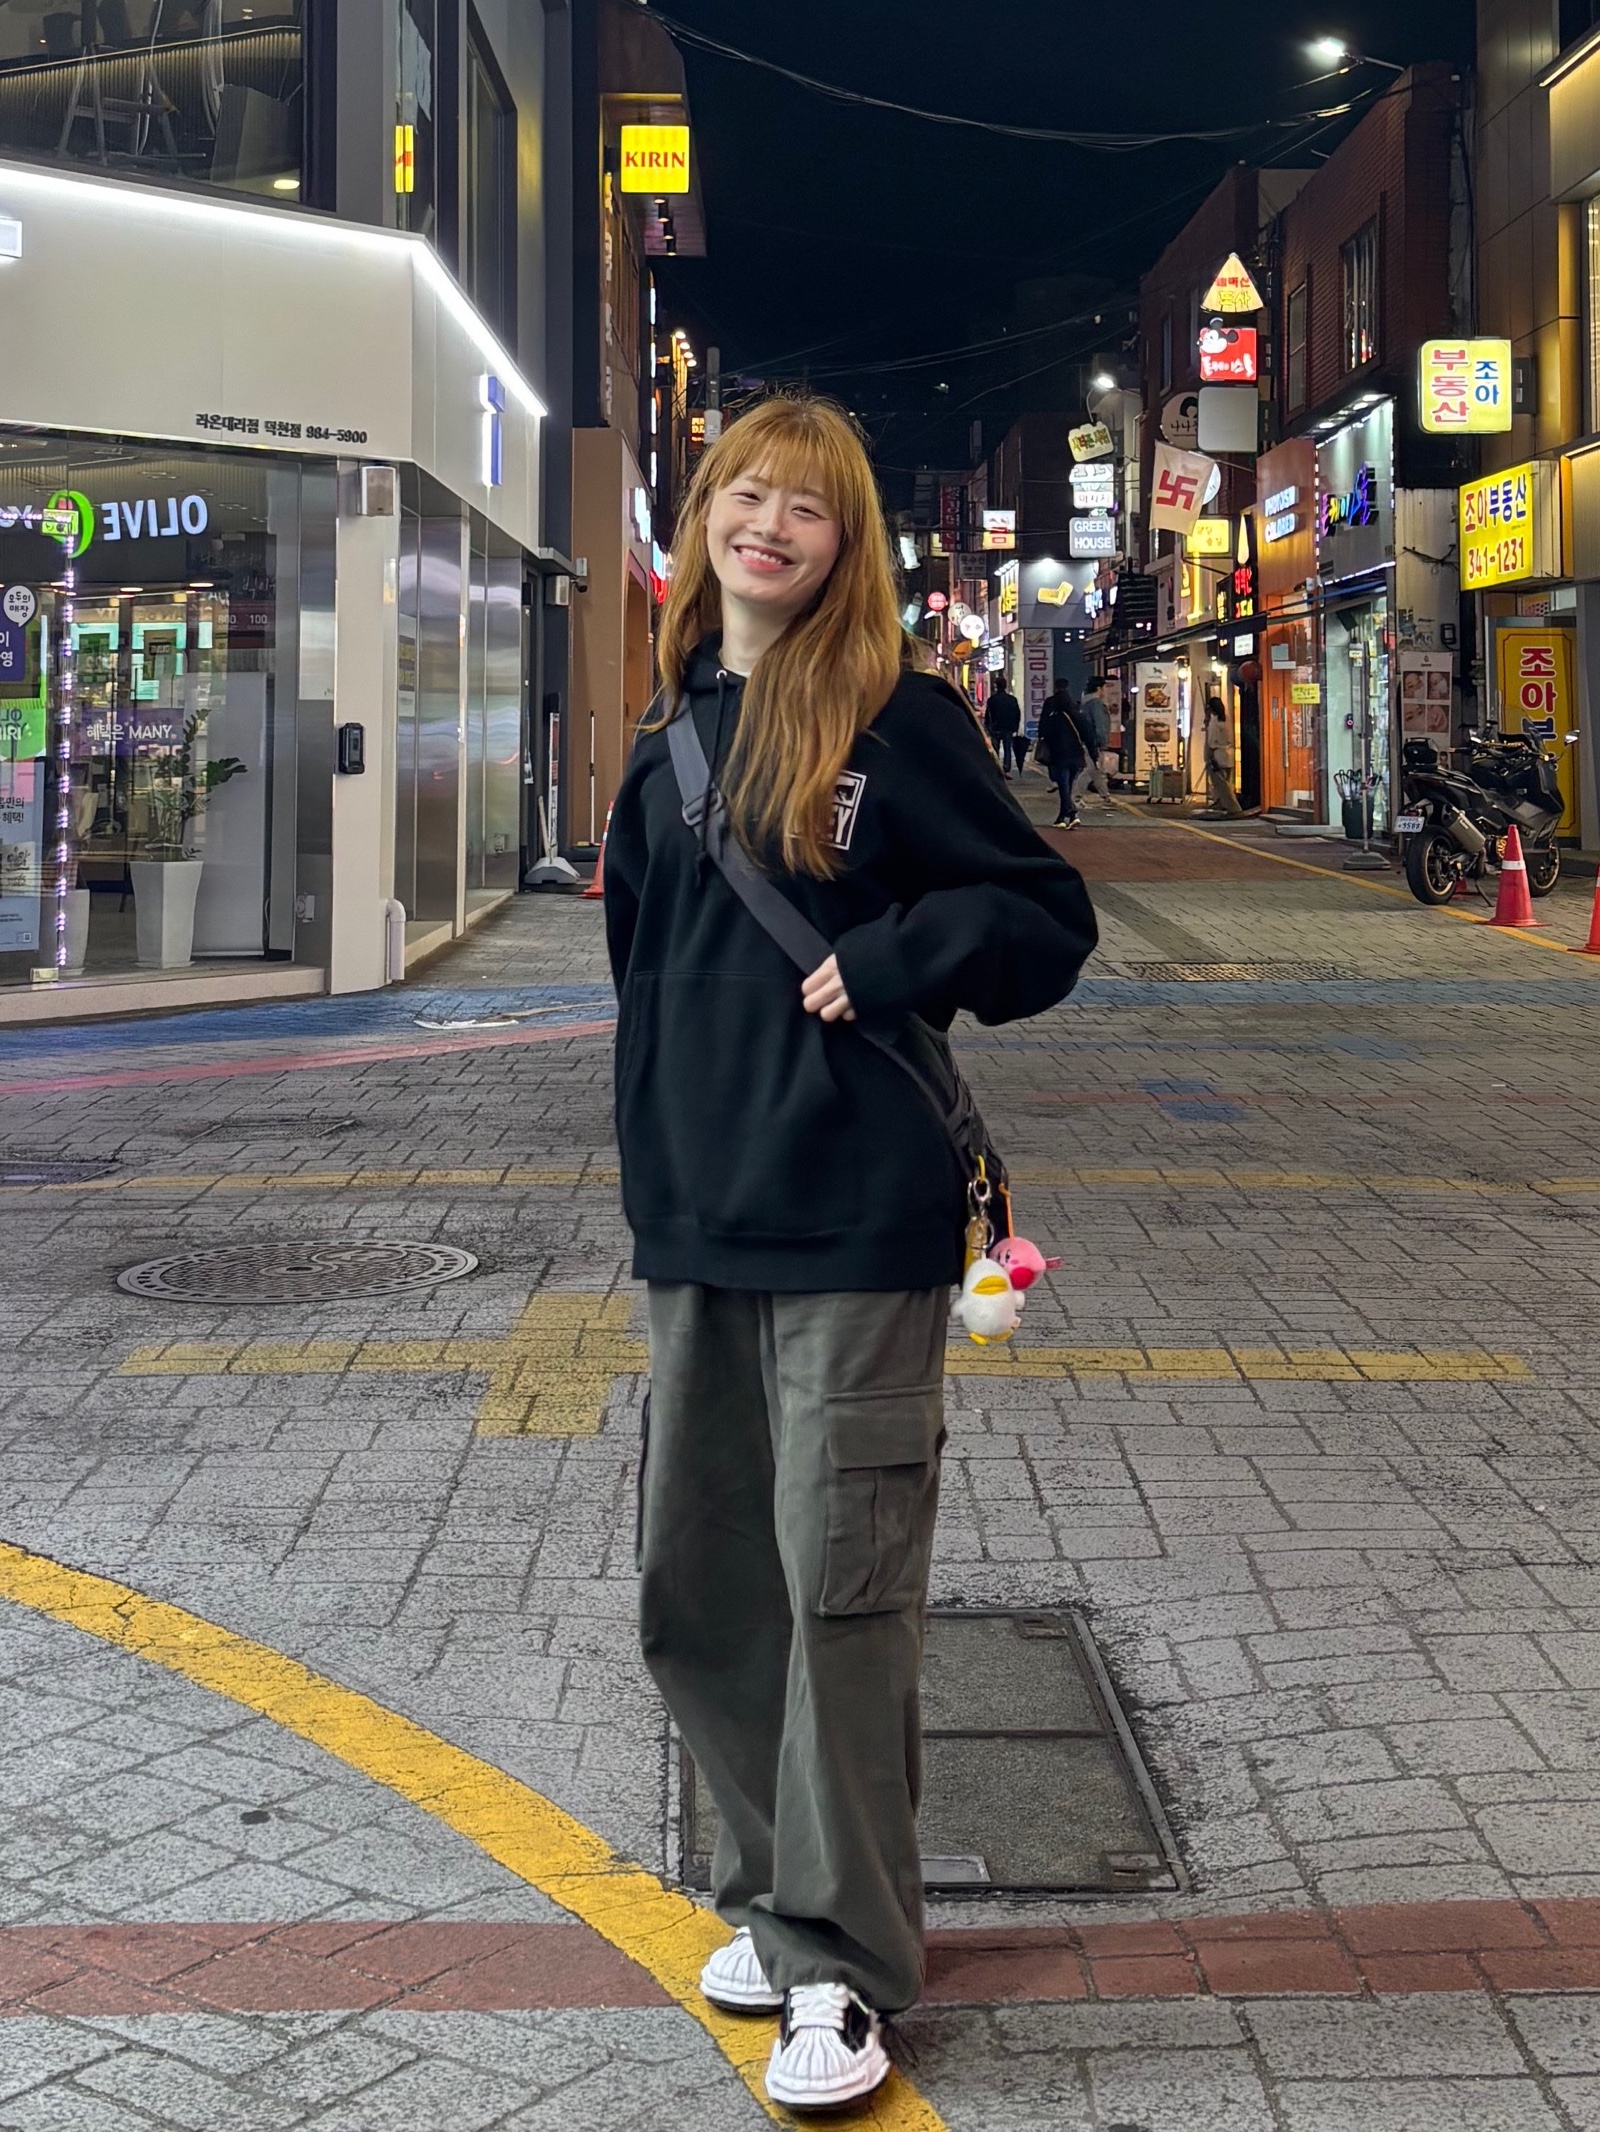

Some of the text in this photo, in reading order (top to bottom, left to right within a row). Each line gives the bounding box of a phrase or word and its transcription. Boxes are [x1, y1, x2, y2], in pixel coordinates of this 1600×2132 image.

[625, 151, 685, 168] KIRIN
[1431, 349, 1470, 423] 부동산
[1475, 360, 1500, 405] 조아
[195, 413, 368, 444] 라온대리점 덕천점 984-5900
[1464, 473, 1527, 534] 조아부동산
[1074, 521, 1111, 533] GREEN
[1074, 537, 1113, 549] HOUSE
[1468, 536, 1525, 580] 341-1231
[86, 724, 172, 740] 혜택은 MANY
